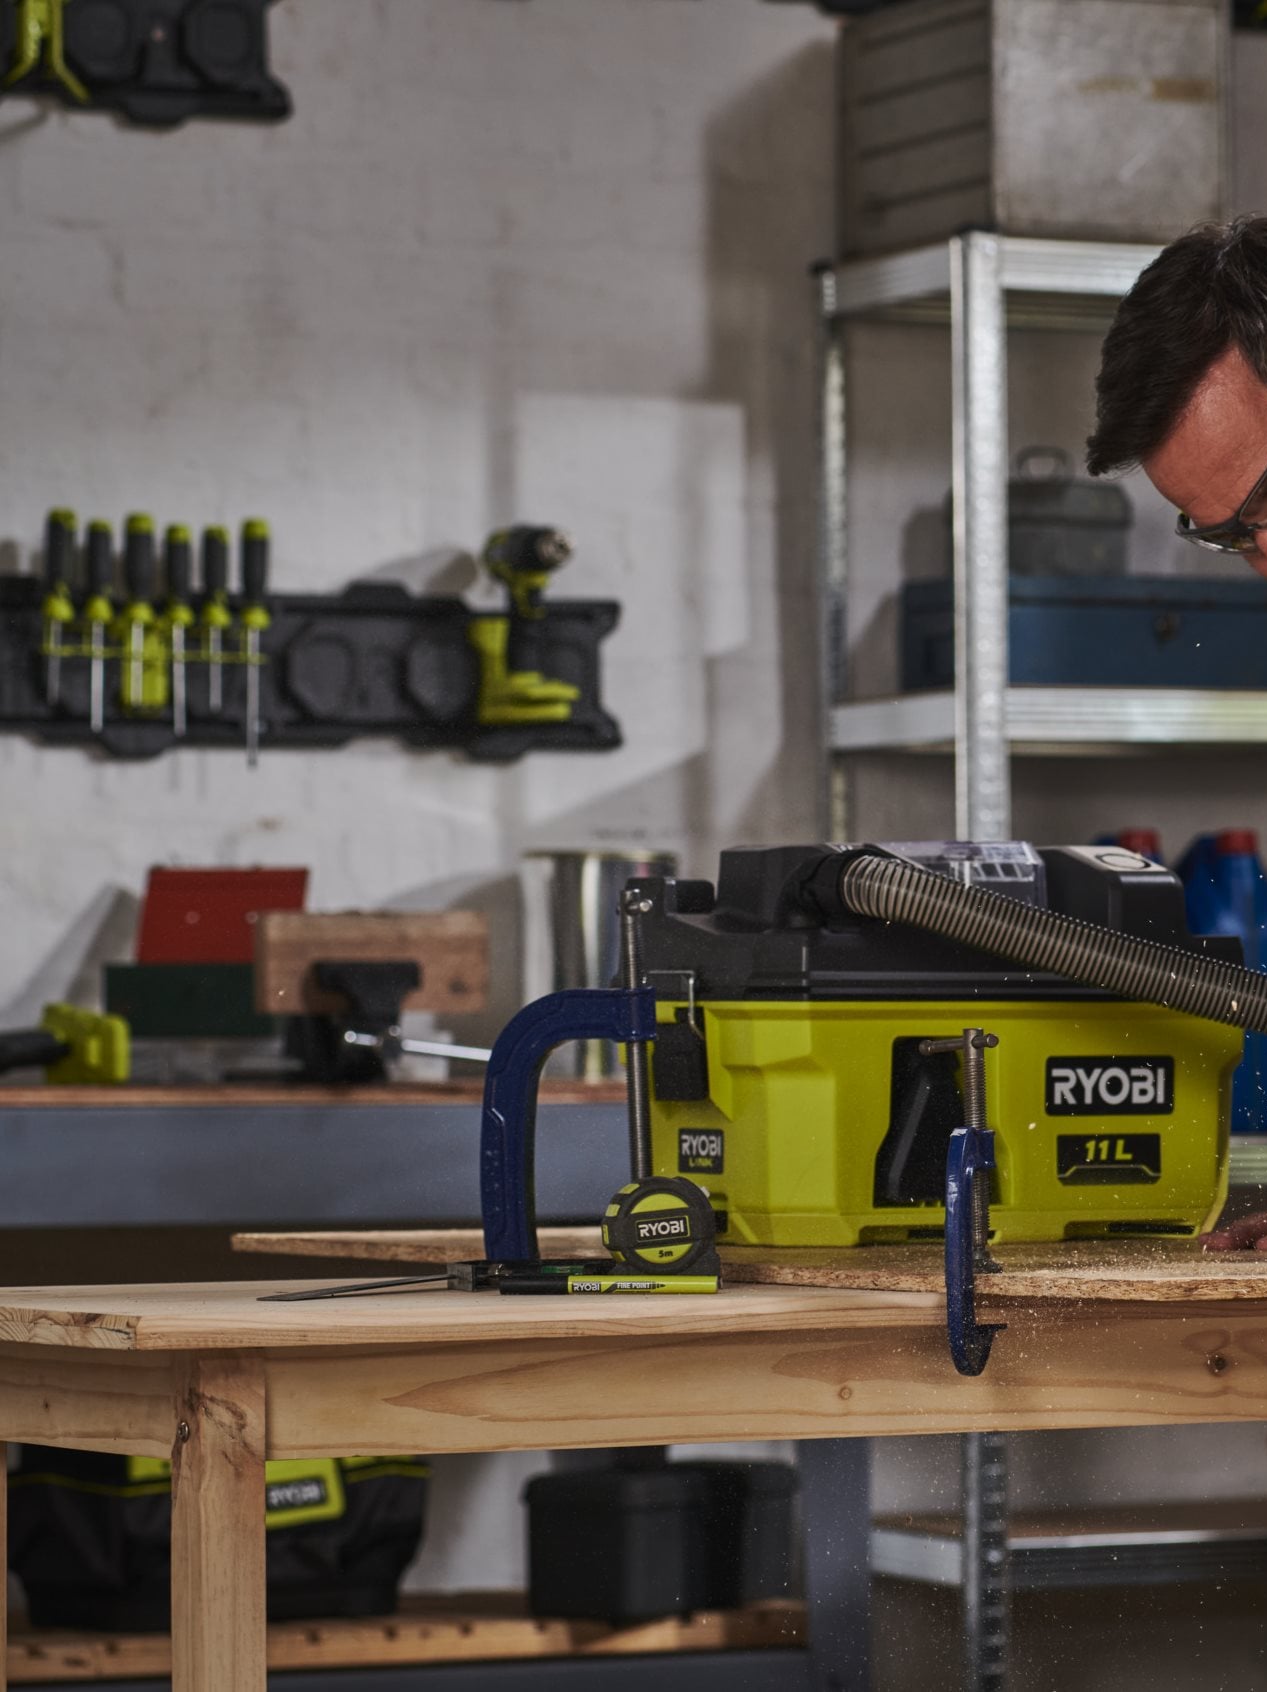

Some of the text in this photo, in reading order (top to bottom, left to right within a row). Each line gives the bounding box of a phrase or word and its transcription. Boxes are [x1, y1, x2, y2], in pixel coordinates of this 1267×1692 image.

[1050, 1067, 1165, 1105] RYOBI
[681, 1134, 722, 1157] RYOBI
[1085, 1139, 1133, 1161] 11 L
[638, 1219, 685, 1237] RYOBI
[658, 1250, 674, 1258] 5m
[573, 1282, 600, 1291] RYOBI
